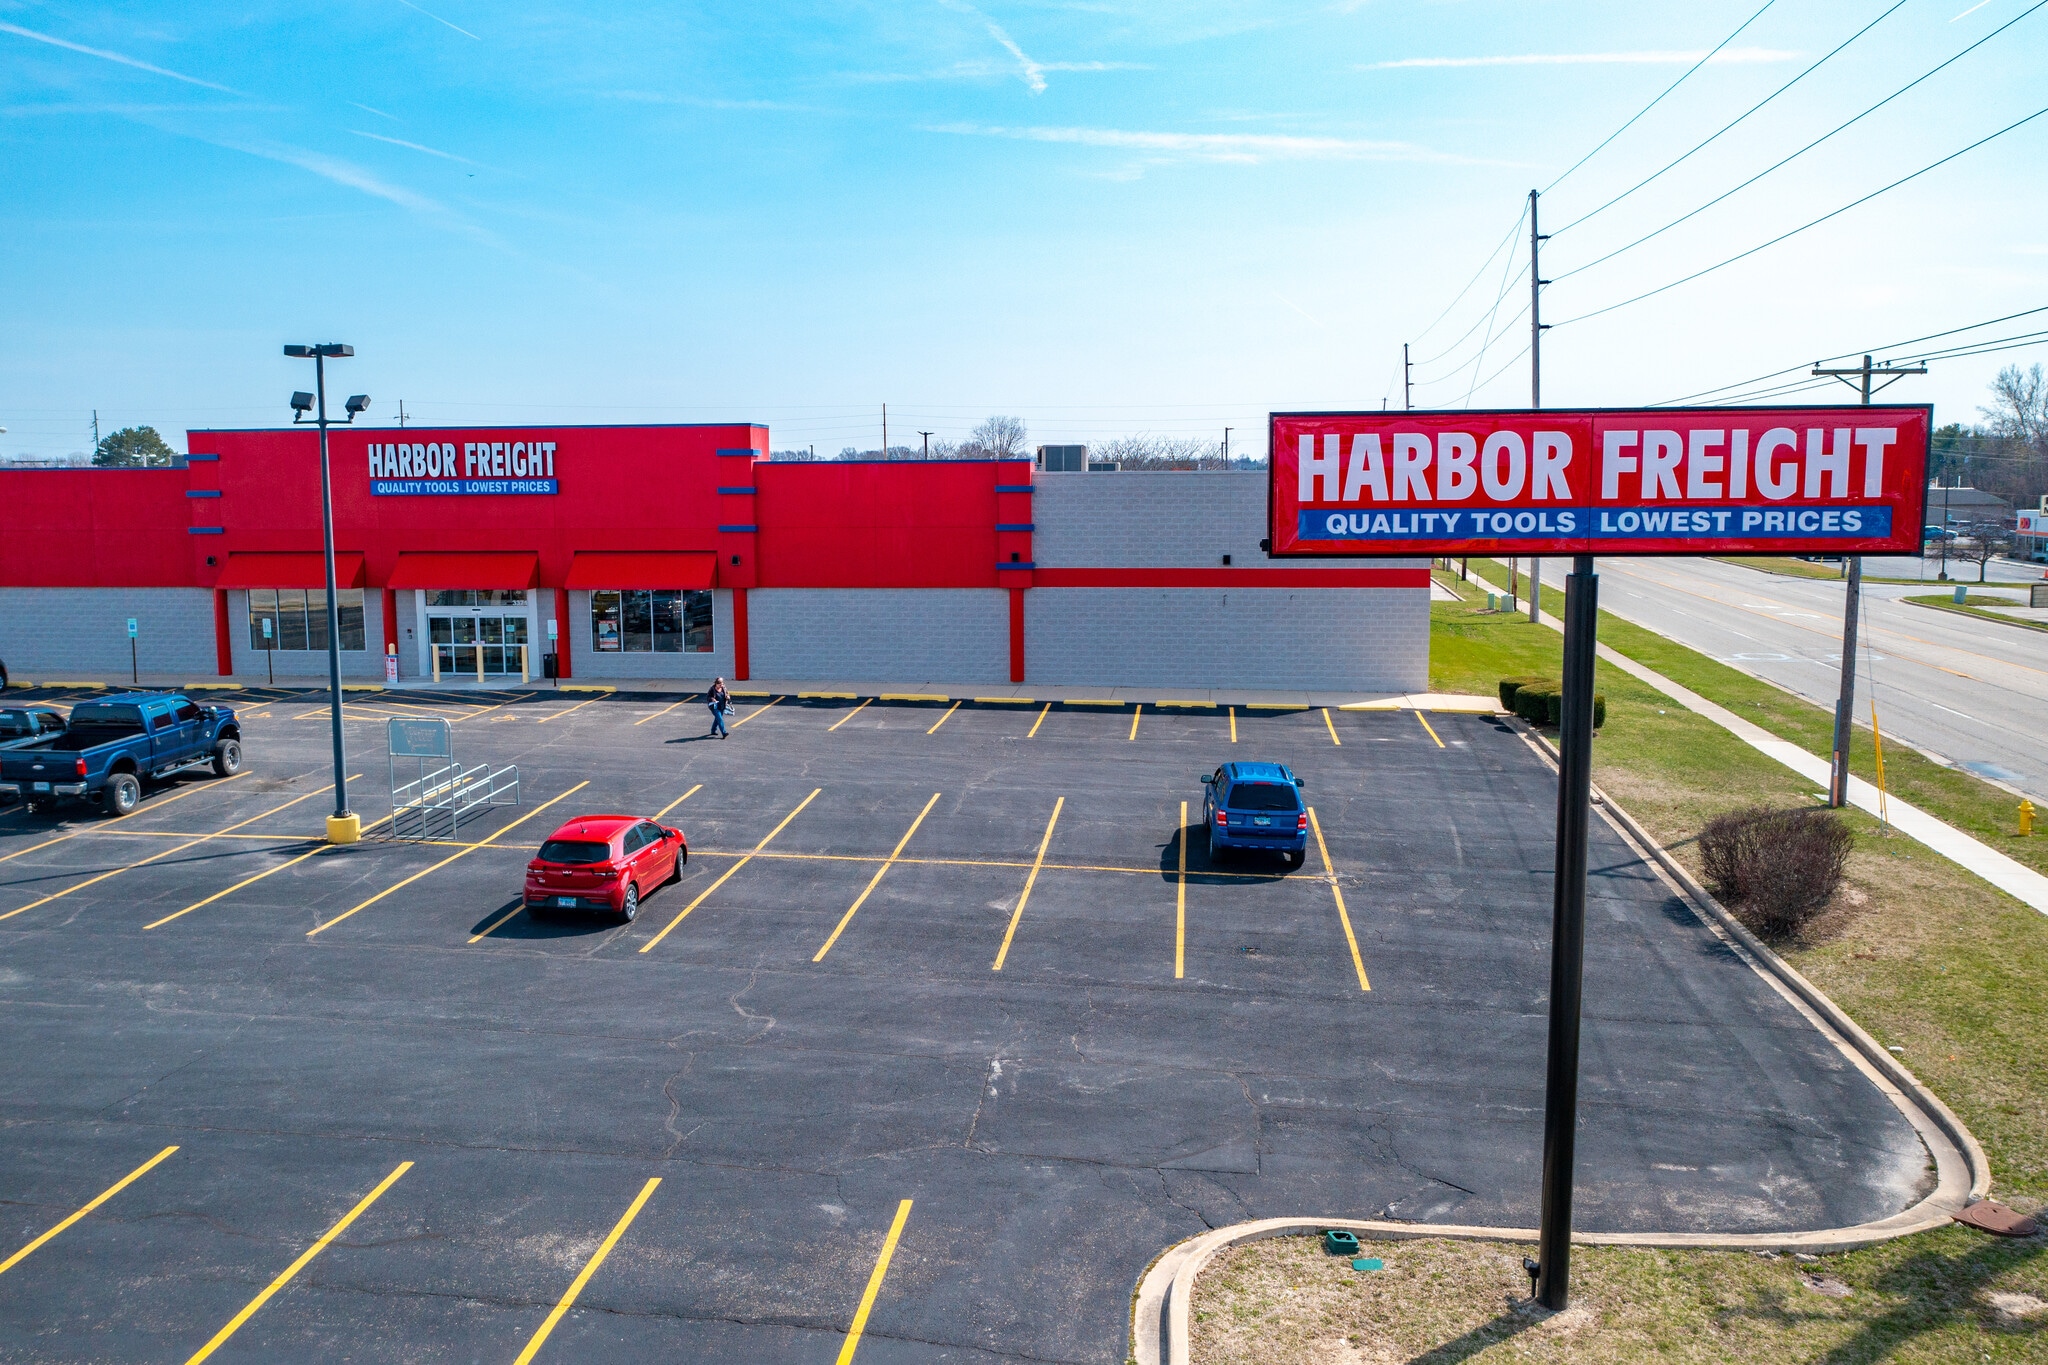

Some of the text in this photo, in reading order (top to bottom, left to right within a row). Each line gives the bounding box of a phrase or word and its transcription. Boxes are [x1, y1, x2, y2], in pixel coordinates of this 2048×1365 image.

[368, 441, 556, 478] HARBOR FREIGHT
[1298, 427, 1898, 502] HARBOR FREIGHT
[377, 481, 550, 493] QUALITY TOOLS LOWEST PRICES
[1326, 510, 1862, 535] QUALITY TOOLS LOWEST PRICES
